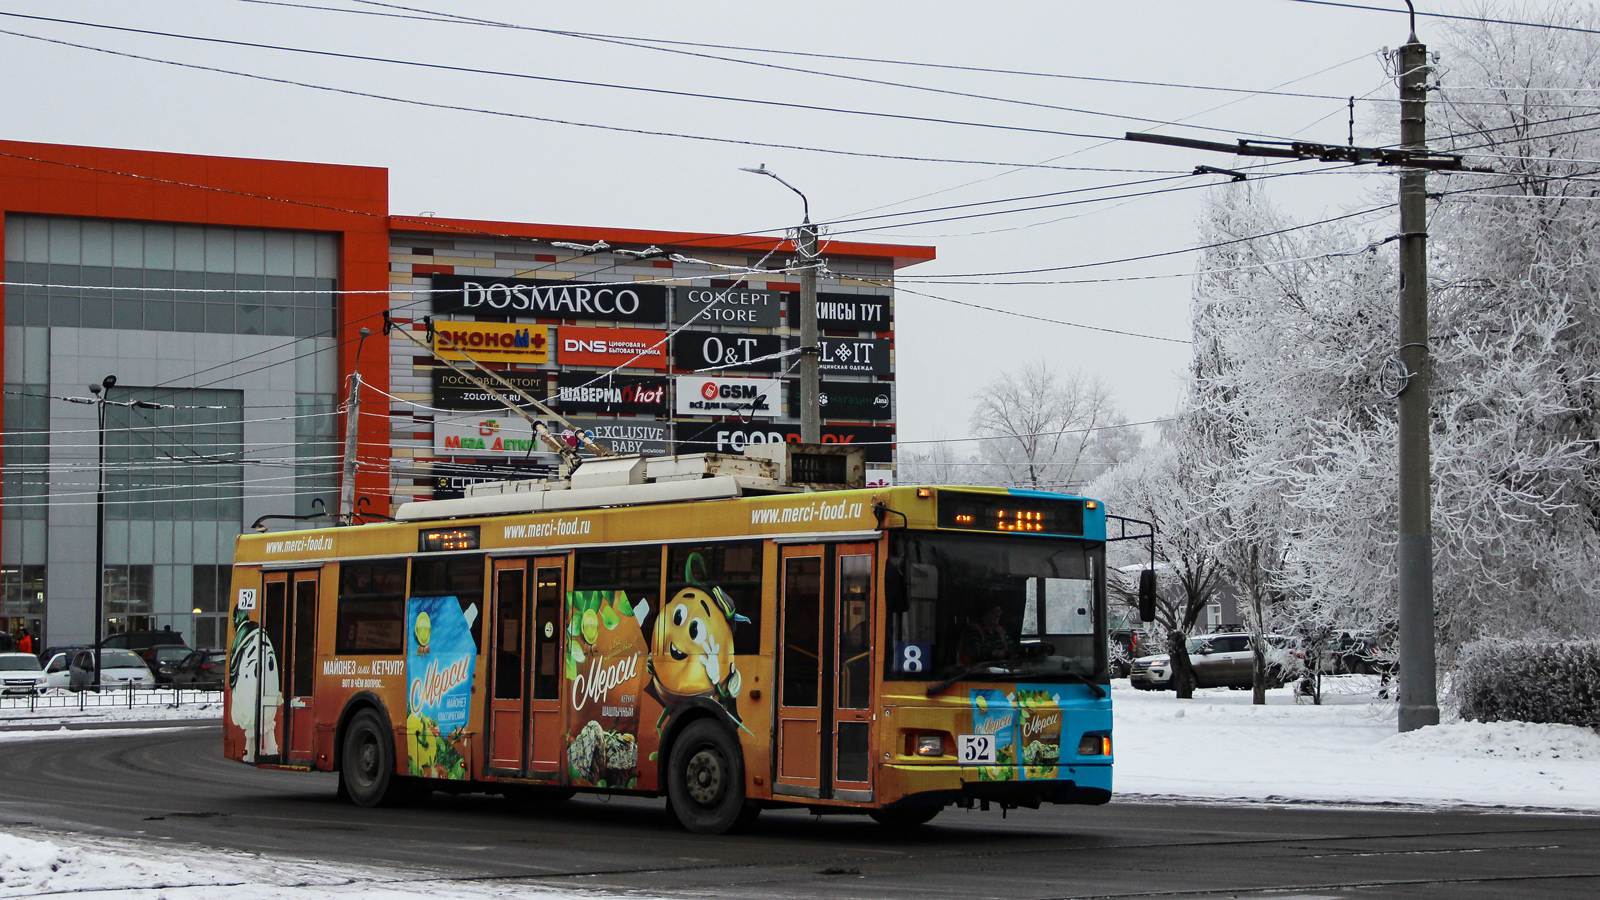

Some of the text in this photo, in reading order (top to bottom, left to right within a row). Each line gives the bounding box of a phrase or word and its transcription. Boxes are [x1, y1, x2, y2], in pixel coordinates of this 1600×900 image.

[463, 281, 640, 315] DOSMARCO
[688, 290, 771, 306] CONCEPT
[701, 308, 757, 322] STORE
[860, 303, 882, 322] ТУТ
[564, 339, 608, 353] DNS
[608, 347, 635, 355] БЫТОВАЯ
[702, 337, 758, 365] O&T
[560, 386, 623, 403] ШАВЕРМА
[634, 385, 664, 404] hot
[719, 384, 757, 399] GSM
[594, 425, 664, 441] EXCLUSIVE
[611, 440, 643, 453] BABY
[751, 499, 863, 525] www.merci-food.ru
[504, 517, 591, 539] www.merci-food.ru
[266, 535, 333, 554] www.merci-food.ru
[241, 590, 254, 608] 52
[323, 660, 356, 675] МАЙОНЕЗ
[371, 660, 404, 675] КЕТЧУП?
[903, 645, 923, 673] 8
[410, 656, 468, 713] Мерси
[572, 653, 638, 711] Мерси
[1023, 713, 1058, 738] Мерси
[965, 737, 989, 761] 52
